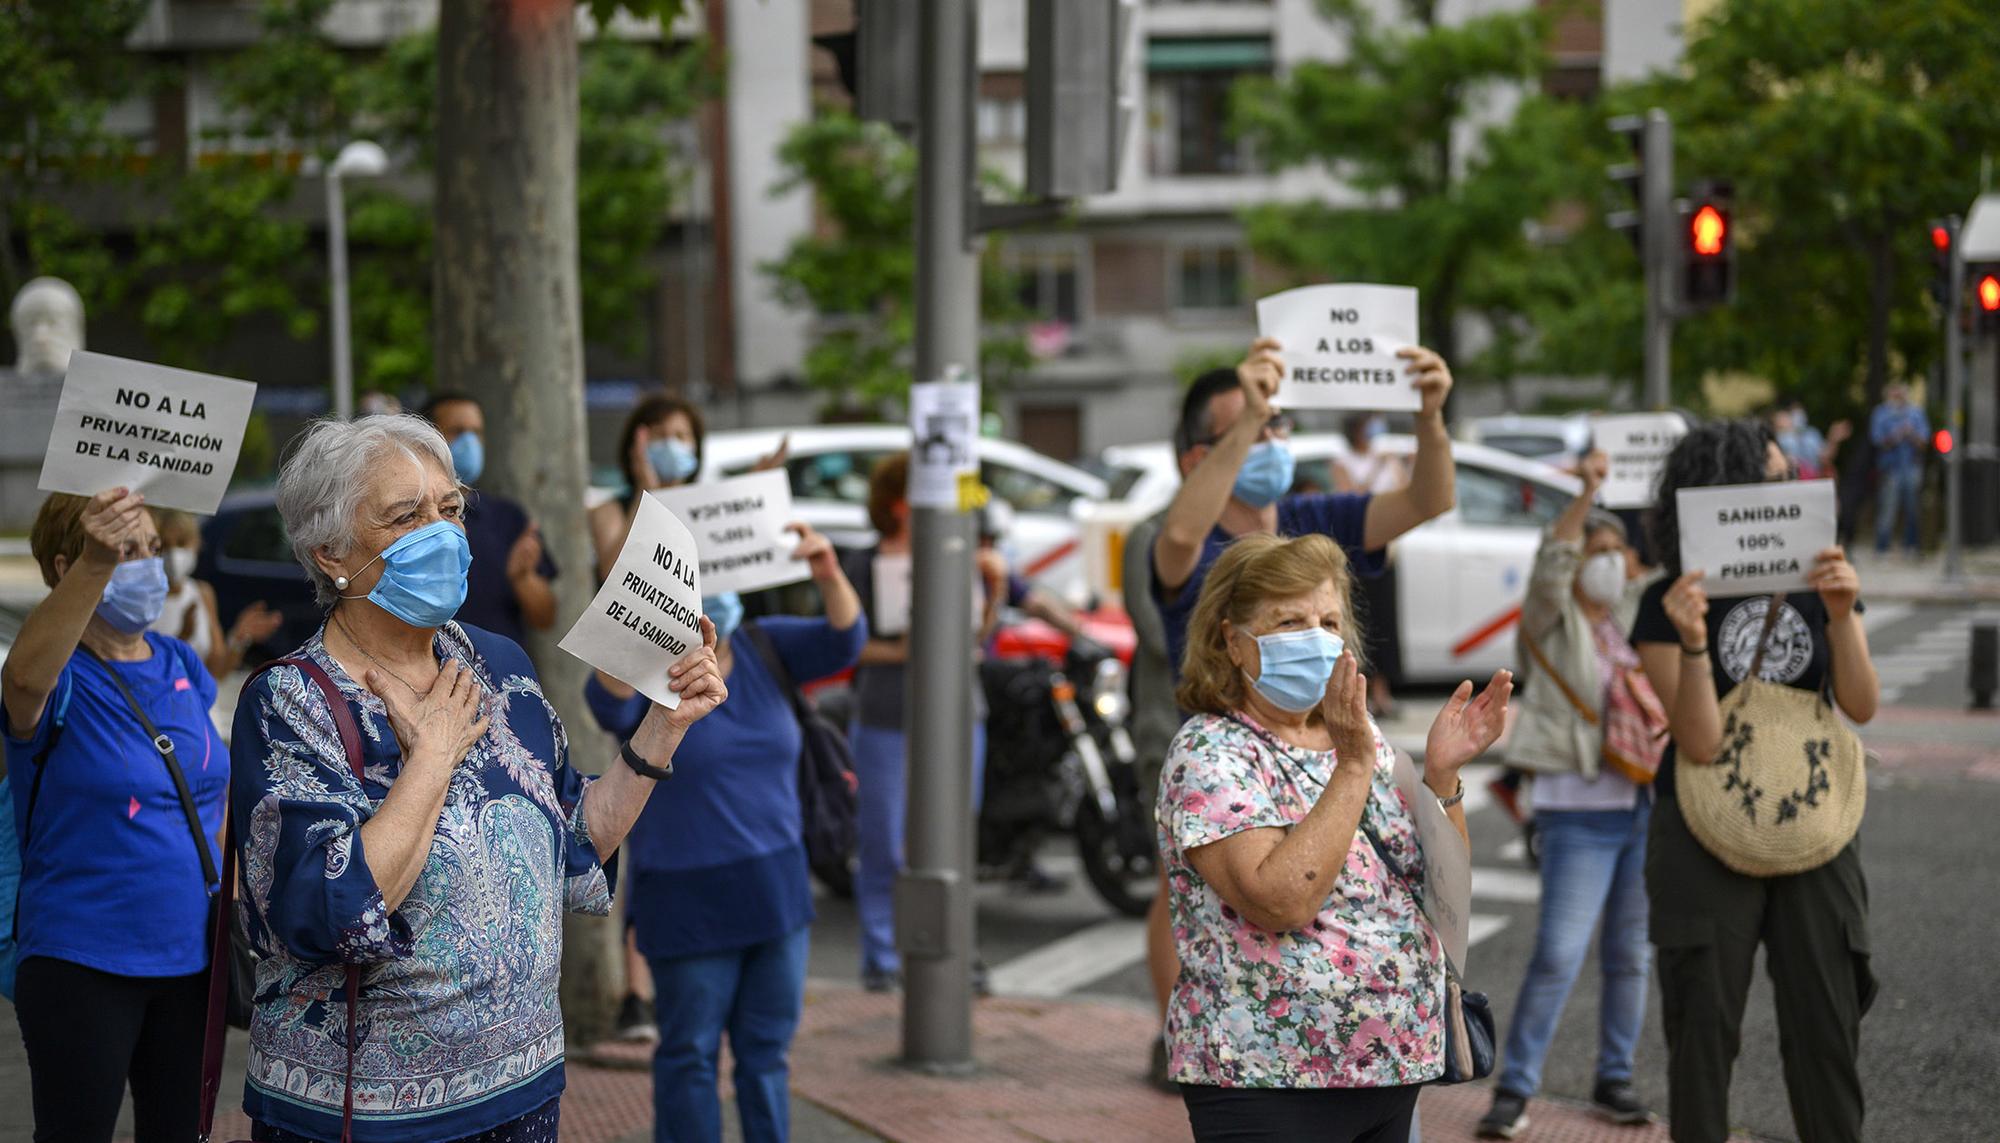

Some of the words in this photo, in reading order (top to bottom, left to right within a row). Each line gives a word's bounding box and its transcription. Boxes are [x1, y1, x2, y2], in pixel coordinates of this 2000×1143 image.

[1330, 308, 1359, 323] NO
[1317, 339, 1330, 352] A
[1336, 338, 1374, 353] LOS
[1292, 367, 1396, 384] RECORTES
[115, 388, 150, 409] NO
[156, 396, 173, 414] A
[179, 399, 206, 420] LA
[80, 415, 223, 452] PRIVATIZACIÓN
[75, 440, 102, 457] DE
[106, 445, 130, 462] LA
[136, 450, 214, 476] SANIDAD
[1717, 504, 1802, 525] SANIDAD
[1737, 533, 1786, 551] 100%
[652, 542, 673, 570] NO
[673, 559, 682, 580] A
[683, 564, 696, 592] LA
[1720, 557, 1800, 580] PÚBLICA
[622, 571, 701, 634] PRIVATIZACIÓN
[605, 600, 624, 621] DE
[622, 610, 640, 633] LA
[639, 620, 687, 656] SANIDAD
